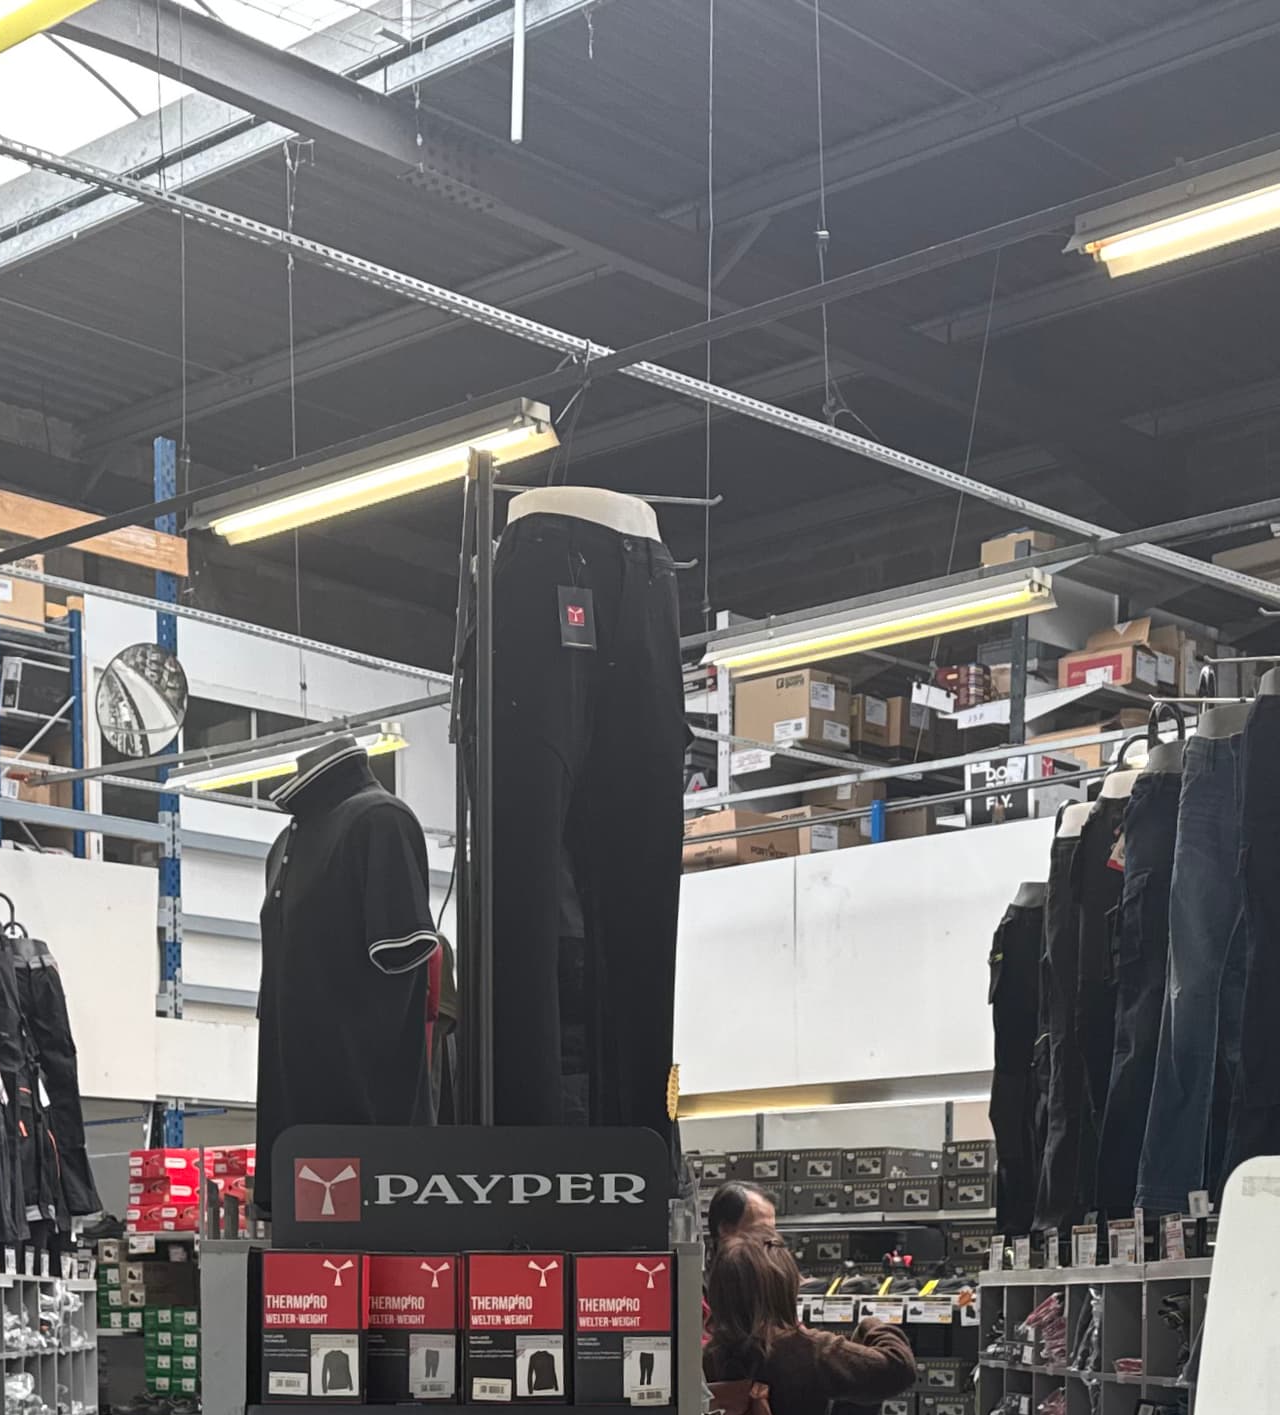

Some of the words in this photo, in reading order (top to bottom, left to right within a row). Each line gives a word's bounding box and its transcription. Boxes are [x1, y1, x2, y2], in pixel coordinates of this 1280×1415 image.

[373, 1172, 648, 1206] PAYPER
[265, 1313, 328, 1325] WELTER-WEIGHT
[471, 1314, 533, 1326] WELTER-WEIGHT
[578, 1316, 641, 1328] WELTER-WEIGHT
